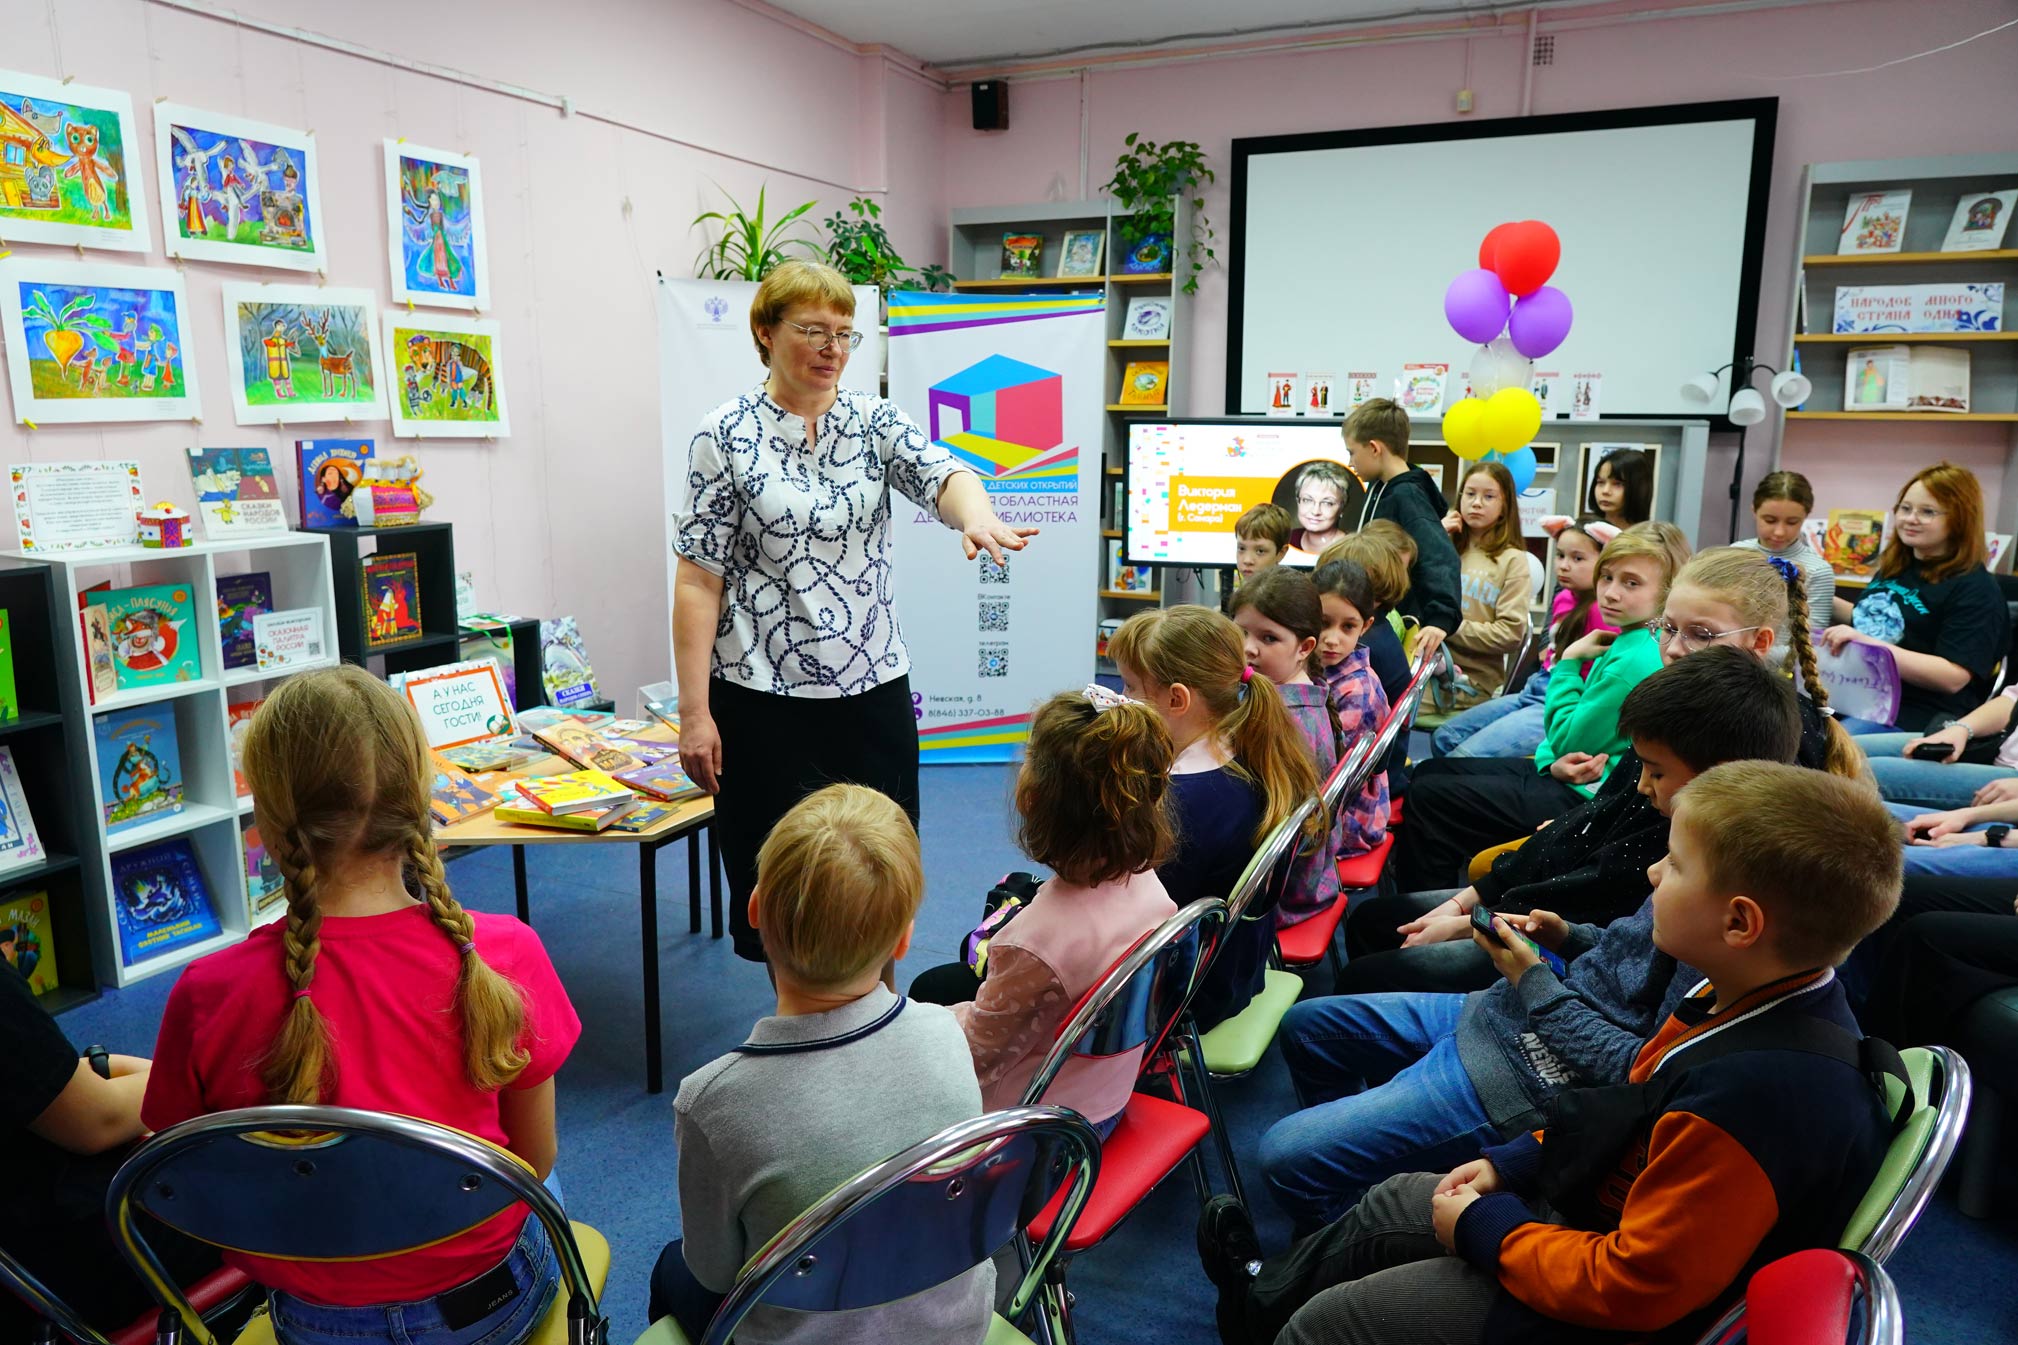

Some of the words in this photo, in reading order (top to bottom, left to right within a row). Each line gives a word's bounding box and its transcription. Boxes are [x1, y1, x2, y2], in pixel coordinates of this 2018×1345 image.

[1850, 296, 1913, 309] НАРОДОВ
[1924, 294, 1974, 307] МНОГО
[1856, 309, 1912, 322] СТРАНА
[1923, 308, 1963, 321] ОДНА
[986, 481, 1028, 490] ДЕТСКИХ
[1031, 479, 1078, 490] ОТКРЫТИЙ
[1177, 484, 1236, 500] Виктория
[999, 495, 1079, 507] ОБЛАСТНАЯ
[1177, 499, 1242, 514] Ледерман
[993, 511, 1078, 523] ИБЛИОТЕКА
[1187, 513, 1224, 524] Самара)
[433, 689, 442, 700] А
[442, 687, 450, 697] У
[452, 681, 477, 696] НАС
[561, 685, 586, 698] СКАЗКИ
[432, 695, 485, 715] СЕГОДНЯ
[928, 695, 965, 703] Невская,
[444, 711, 482, 728] ГОСТИ!
[928, 708, 957, 718] 8(846)
[958, 708, 1005, 717] 337-03-88
[487, 1289, 513, 1310] JEANS
